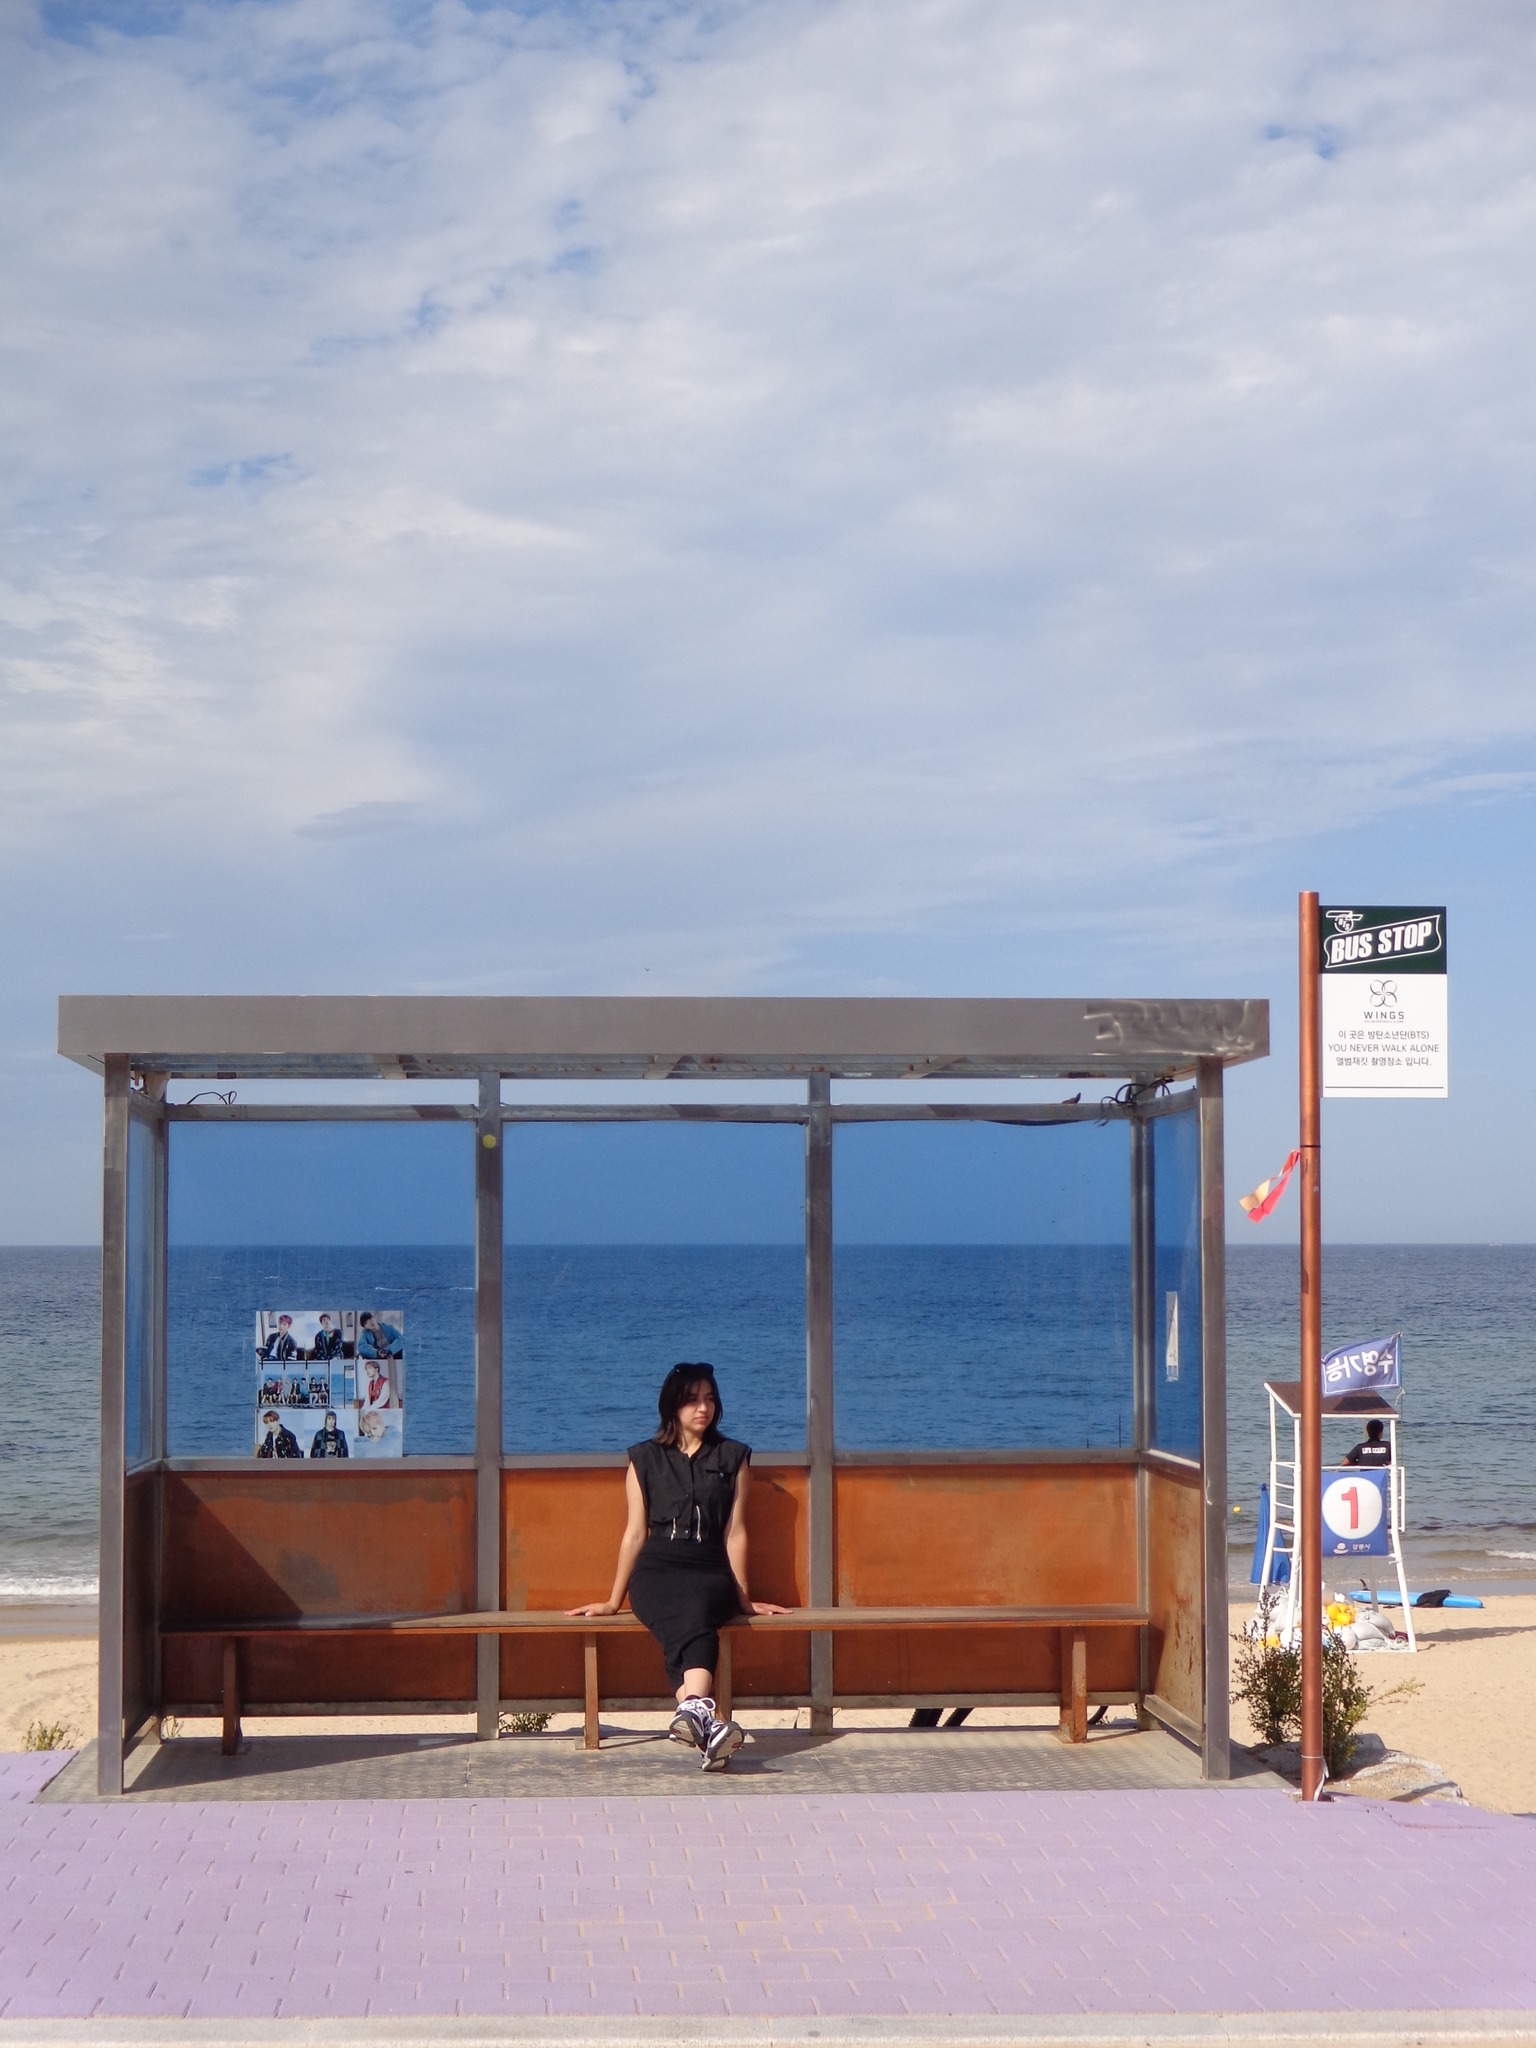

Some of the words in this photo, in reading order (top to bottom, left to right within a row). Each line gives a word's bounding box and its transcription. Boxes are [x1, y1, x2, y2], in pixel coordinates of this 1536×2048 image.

[1338, 918, 1350, 930] BTS
[1331, 933, 1373, 964] BUS
[1378, 921, 1432, 954] STOP
[1363, 1011, 1405, 1020] WINGS
[1338, 1030, 1346, 1040] 이
[1349, 1030, 1365, 1040] 곳은
[1368, 1030, 1430, 1040] 방탄소년단(BTS)
[1328, 1043, 1347, 1052] YOU
[1350, 1043, 1379, 1052] NEVER
[1381, 1043, 1407, 1052] WALK
[1410, 1043, 1440, 1052] ALONE
[1405, 1057, 1432, 1066] 입니다.
[1341, 1486, 1359, 1529] 1
